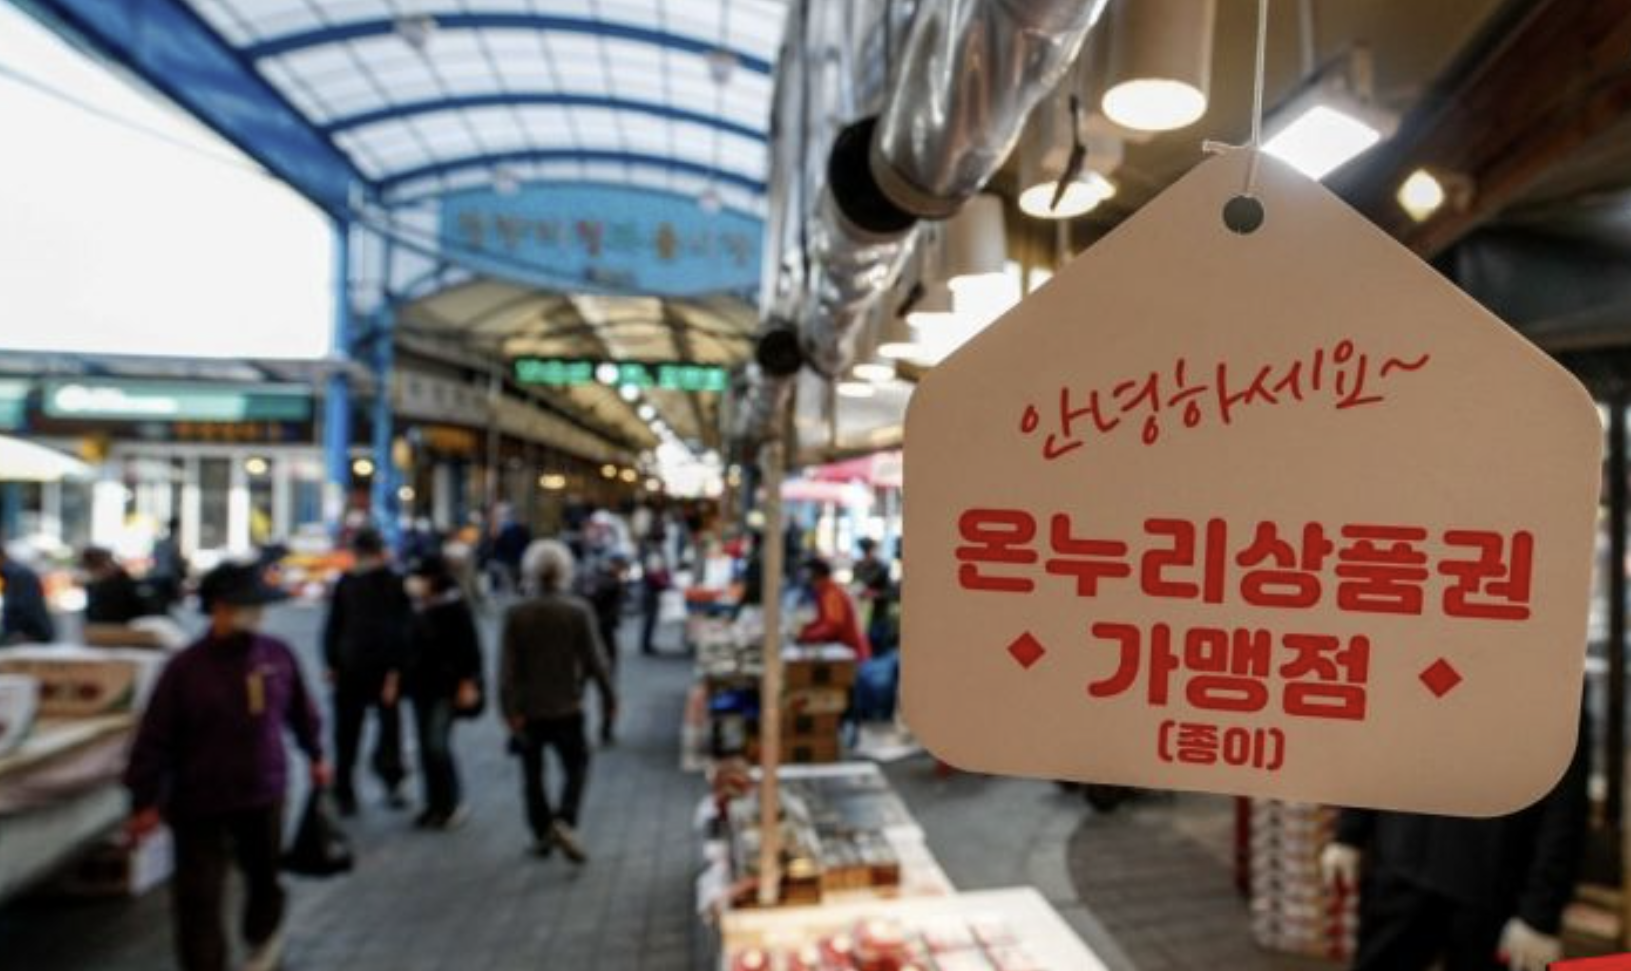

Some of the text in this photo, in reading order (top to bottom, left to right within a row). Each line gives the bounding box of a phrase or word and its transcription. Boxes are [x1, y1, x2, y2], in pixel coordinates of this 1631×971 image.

[1020, 340, 1430, 459] 안녕하세요~
[954, 507, 1535, 621] 온누리상품권
[1087, 621, 1371, 721] 가맹점
